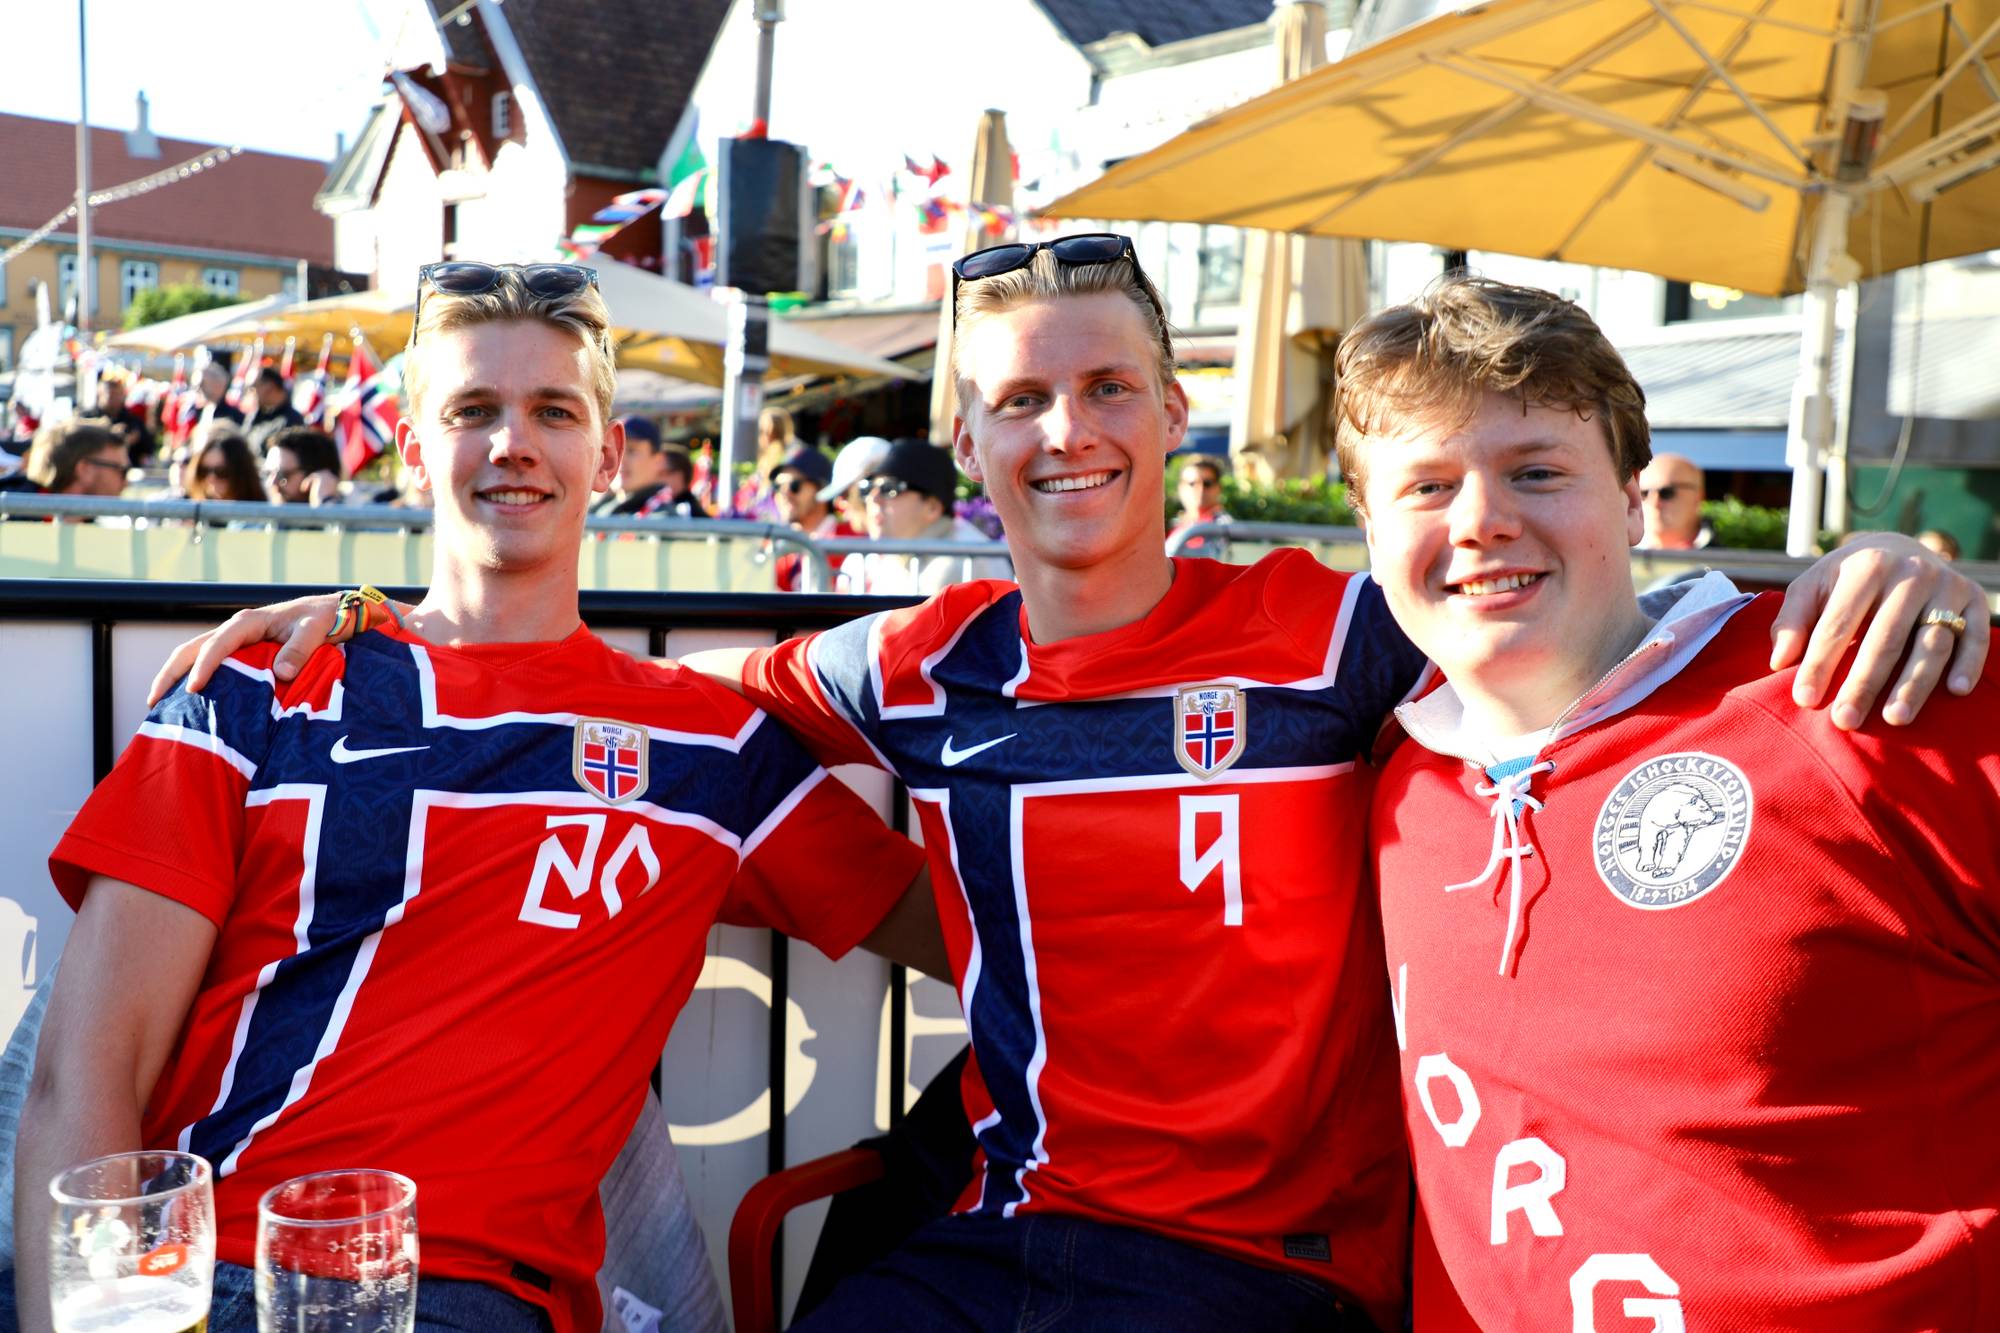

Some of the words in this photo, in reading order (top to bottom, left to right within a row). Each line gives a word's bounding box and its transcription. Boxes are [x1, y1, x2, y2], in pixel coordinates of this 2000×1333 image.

[1199, 691, 1218, 700] NORGE
[1179, 793, 1243, 926] 9
[1599, 792, 1630, 873] NORGES
